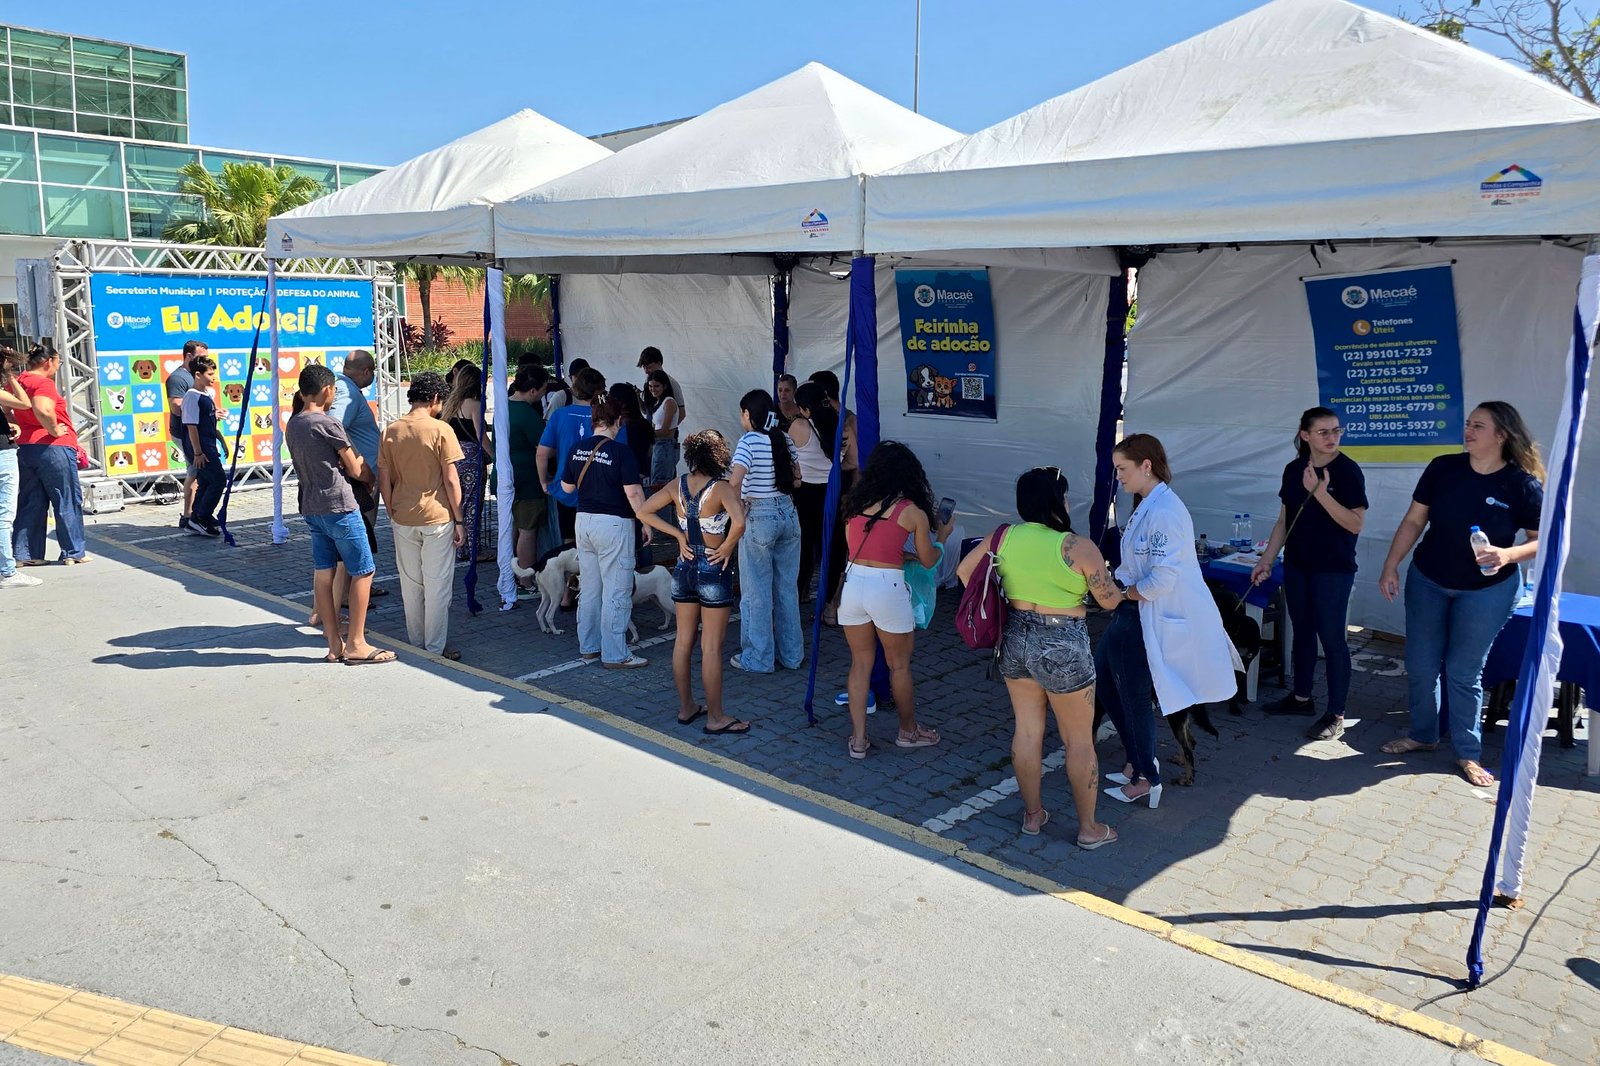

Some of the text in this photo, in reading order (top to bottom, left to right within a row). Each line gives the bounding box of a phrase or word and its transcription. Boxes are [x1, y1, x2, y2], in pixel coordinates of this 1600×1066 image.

[106, 286, 158, 294] Secretaria
[160, 286, 206, 297] Municipal
[216, 286, 268, 298] PROTEÇÃO
[276, 289, 312, 297] DEFESA
[326, 290, 360, 298] ANIMAL
[936, 289, 974, 300] Macaé
[1370, 285, 1417, 299] Macaé
[161, 304, 318, 334] Eu Adotei!
[1372, 318, 1413, 326] Telefones
[914, 318, 979, 334] Feirinha
[907, 335, 991, 352] de adoção
[1334, 342, 1368, 350] Ocorrência
[1343, 348, 1432, 361] (22) 99101-7323
[1346, 366, 1428, 379] (22) 2763-6337
[1344, 384, 1434, 396] (22) 99105-1769
[1346, 402, 1435, 414] (22) 99285-6779
[1346, 421, 1435, 432] (22) 99105-5937
